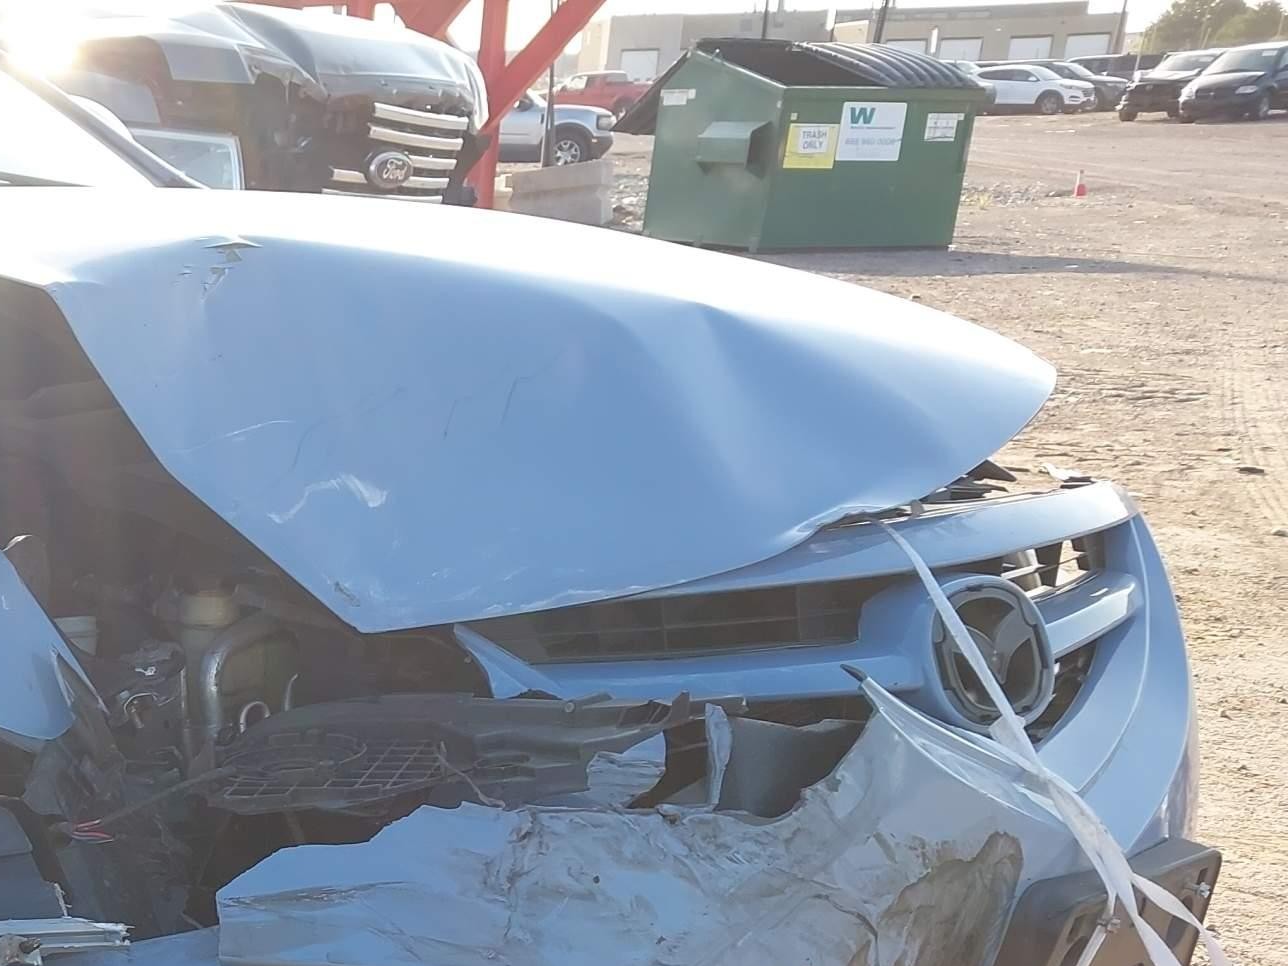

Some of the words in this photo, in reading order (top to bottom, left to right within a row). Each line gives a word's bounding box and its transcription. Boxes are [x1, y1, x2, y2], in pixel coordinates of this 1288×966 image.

[802, 130, 827, 140] TRASH
[802, 140, 824, 150] ONLY
[382, 158, 408, 180] Ford
